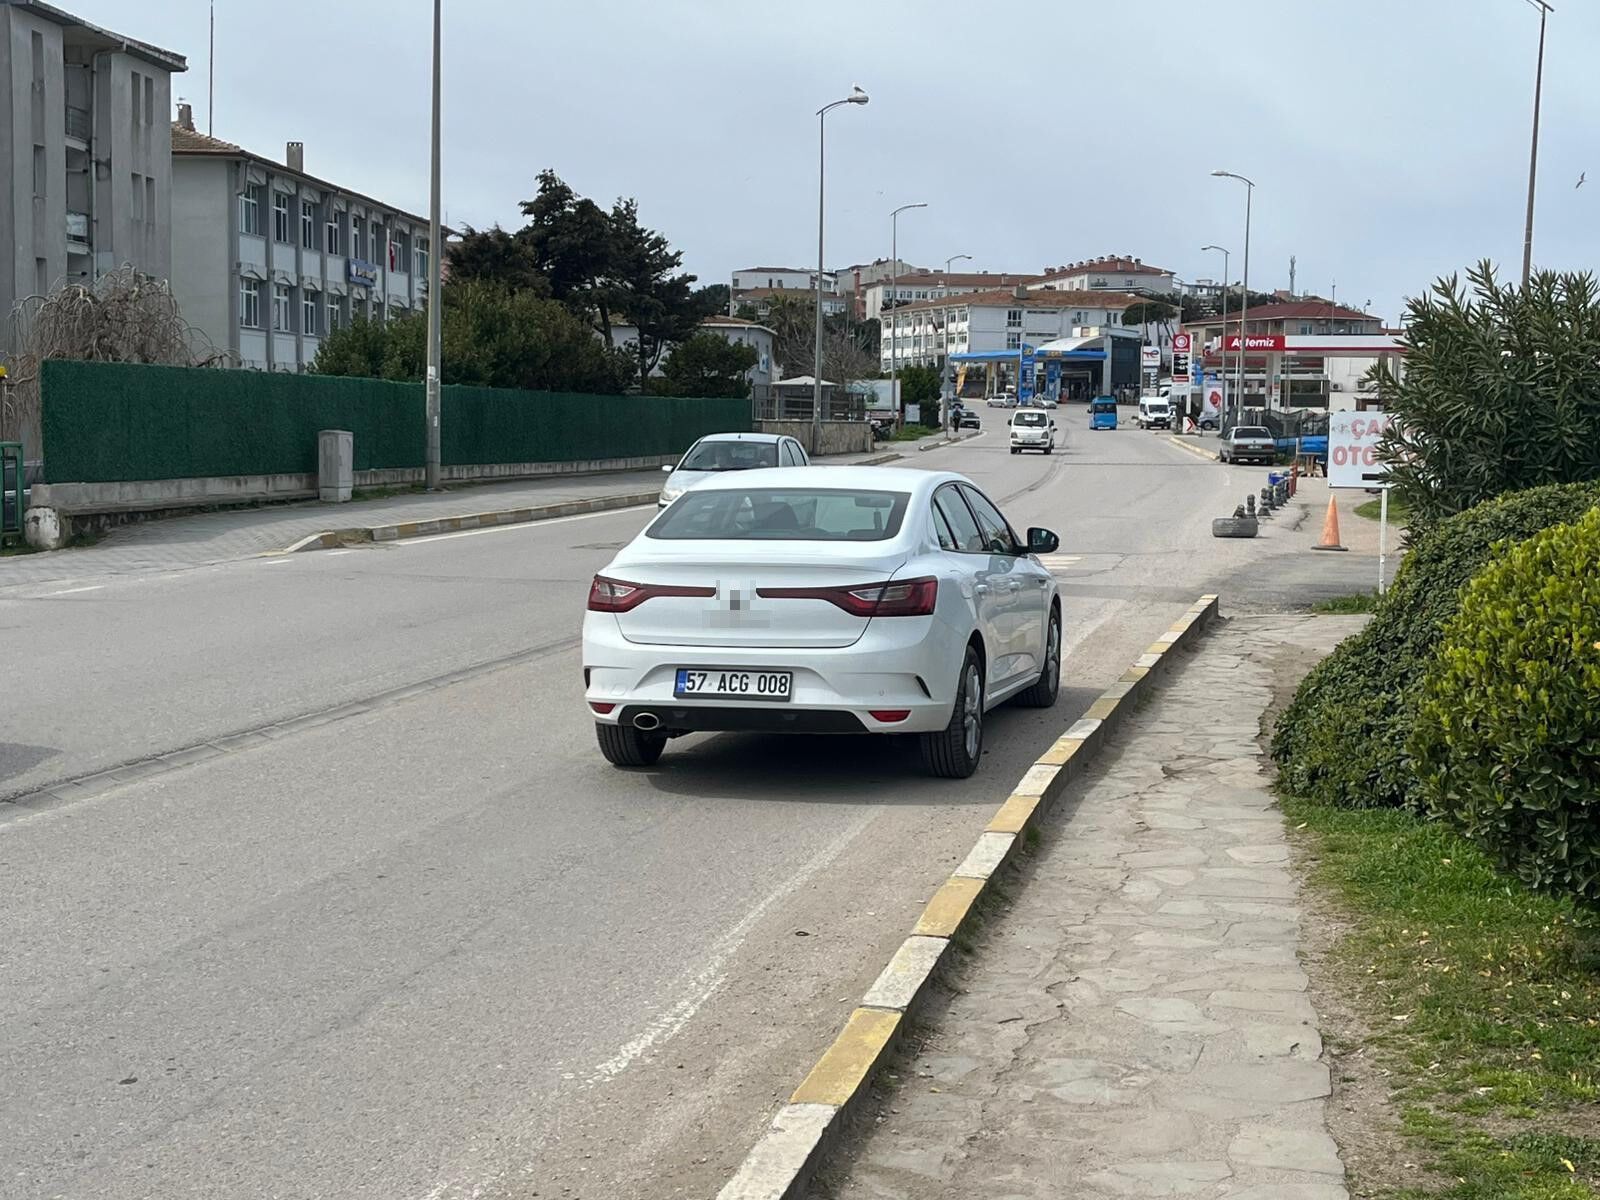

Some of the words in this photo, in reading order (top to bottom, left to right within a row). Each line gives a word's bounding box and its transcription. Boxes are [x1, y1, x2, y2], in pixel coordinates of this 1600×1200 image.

[686, 672, 708, 691] 57
[717, 673, 749, 692] ACG
[757, 675, 789, 694] 008
